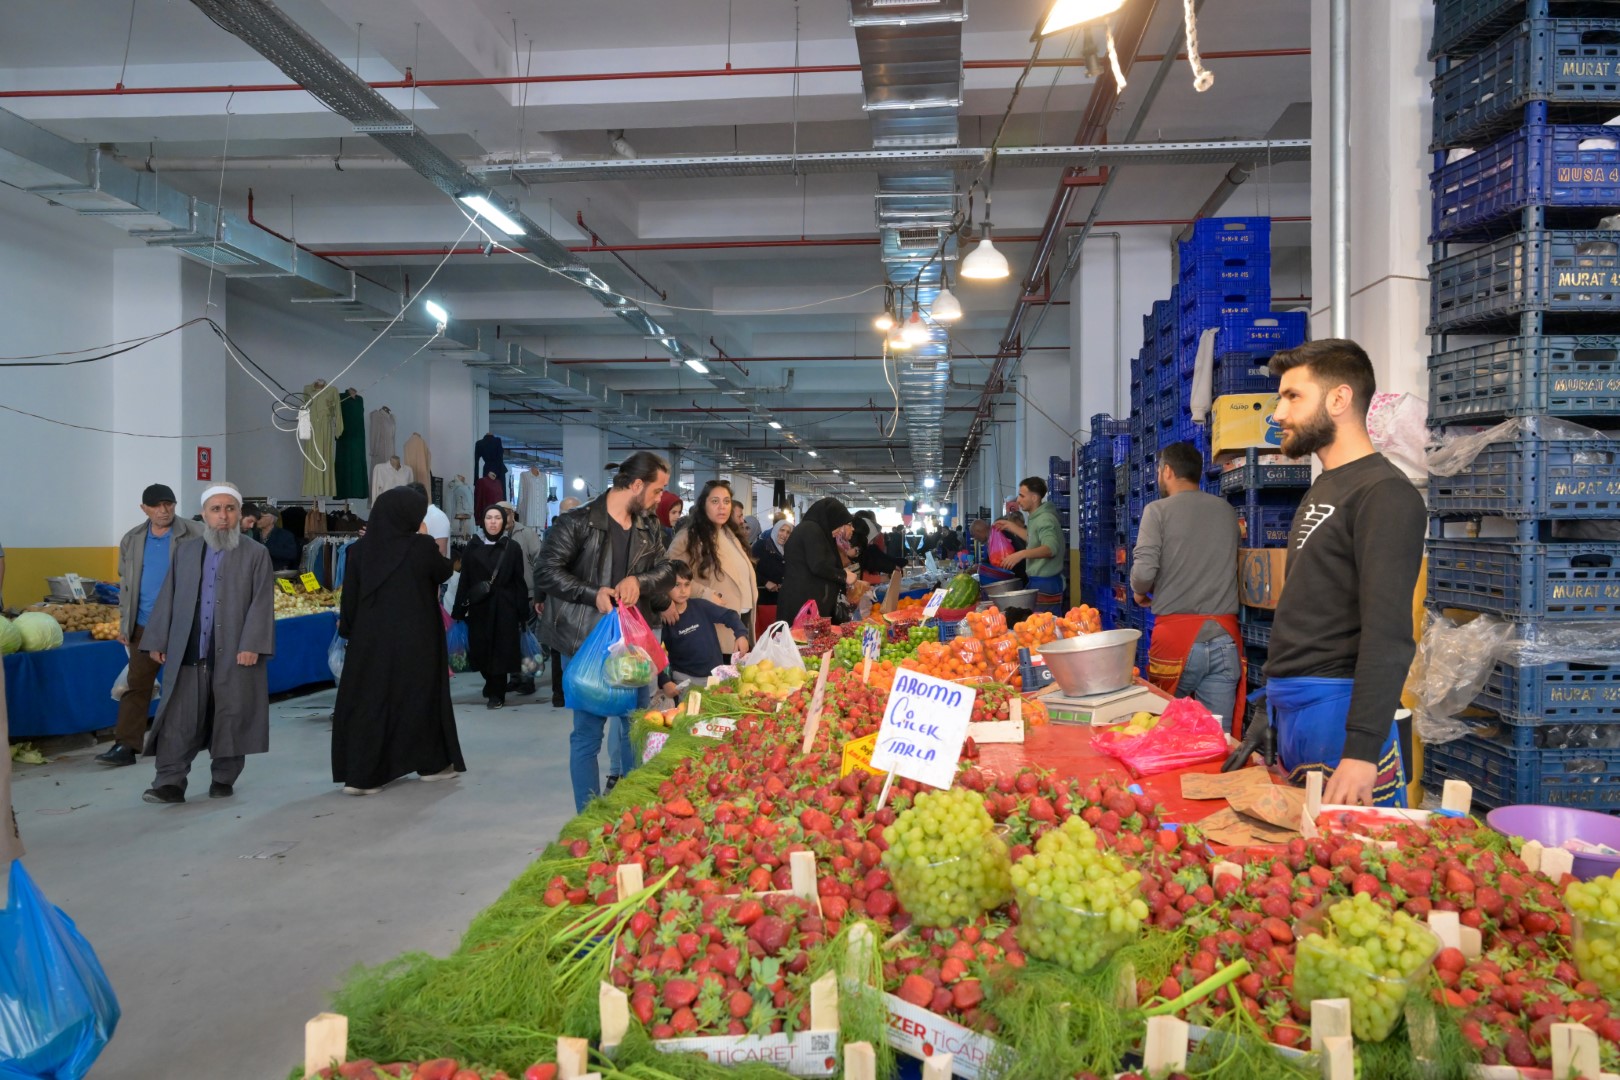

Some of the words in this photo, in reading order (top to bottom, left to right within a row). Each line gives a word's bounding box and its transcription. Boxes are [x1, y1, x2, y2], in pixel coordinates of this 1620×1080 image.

[1562, 62, 1610, 77] MURAT
[1558, 167, 1605, 182] MUSA
[1608, 167, 1619, 182] 4
[1558, 272, 1606, 287] MURAT
[1609, 272, 1620, 287] 4
[1554, 379, 1605, 392] MURAT
[1554, 481, 1603, 496] MURAT
[1552, 584, 1600, 599] MURAT
[895, 675, 962, 708] AROMA
[1551, 687, 1597, 702] MURAT
